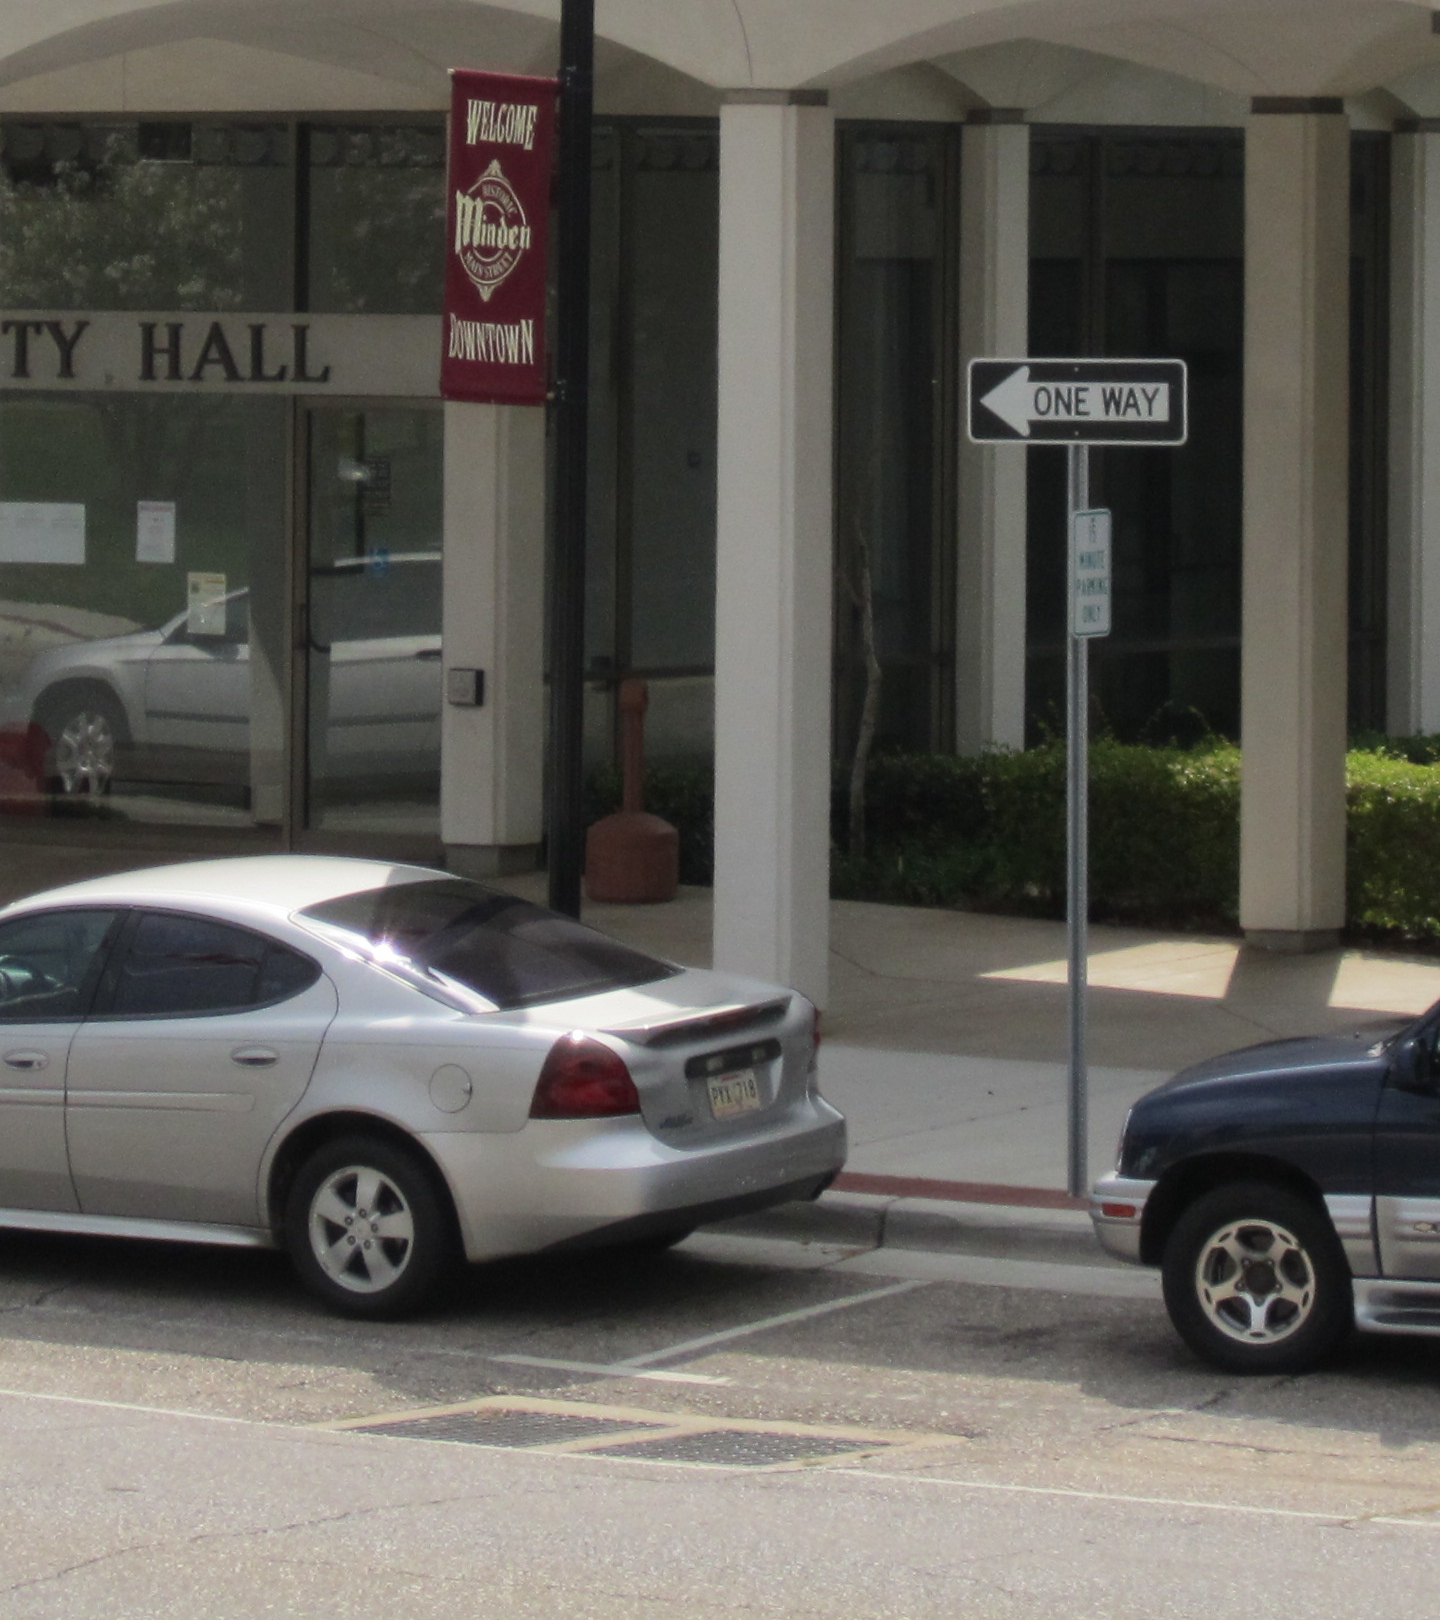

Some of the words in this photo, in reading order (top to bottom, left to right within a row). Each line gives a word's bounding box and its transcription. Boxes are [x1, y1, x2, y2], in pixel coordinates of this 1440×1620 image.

[466, 98, 538, 151] WELCOME
[455, 190, 531, 255] Minden
[138, 321, 330, 383] HALL
[448, 312, 534, 365] DOWNTOWN
[1034, 386, 1090, 416] ONE
[1101, 387, 1160, 417] WAY
